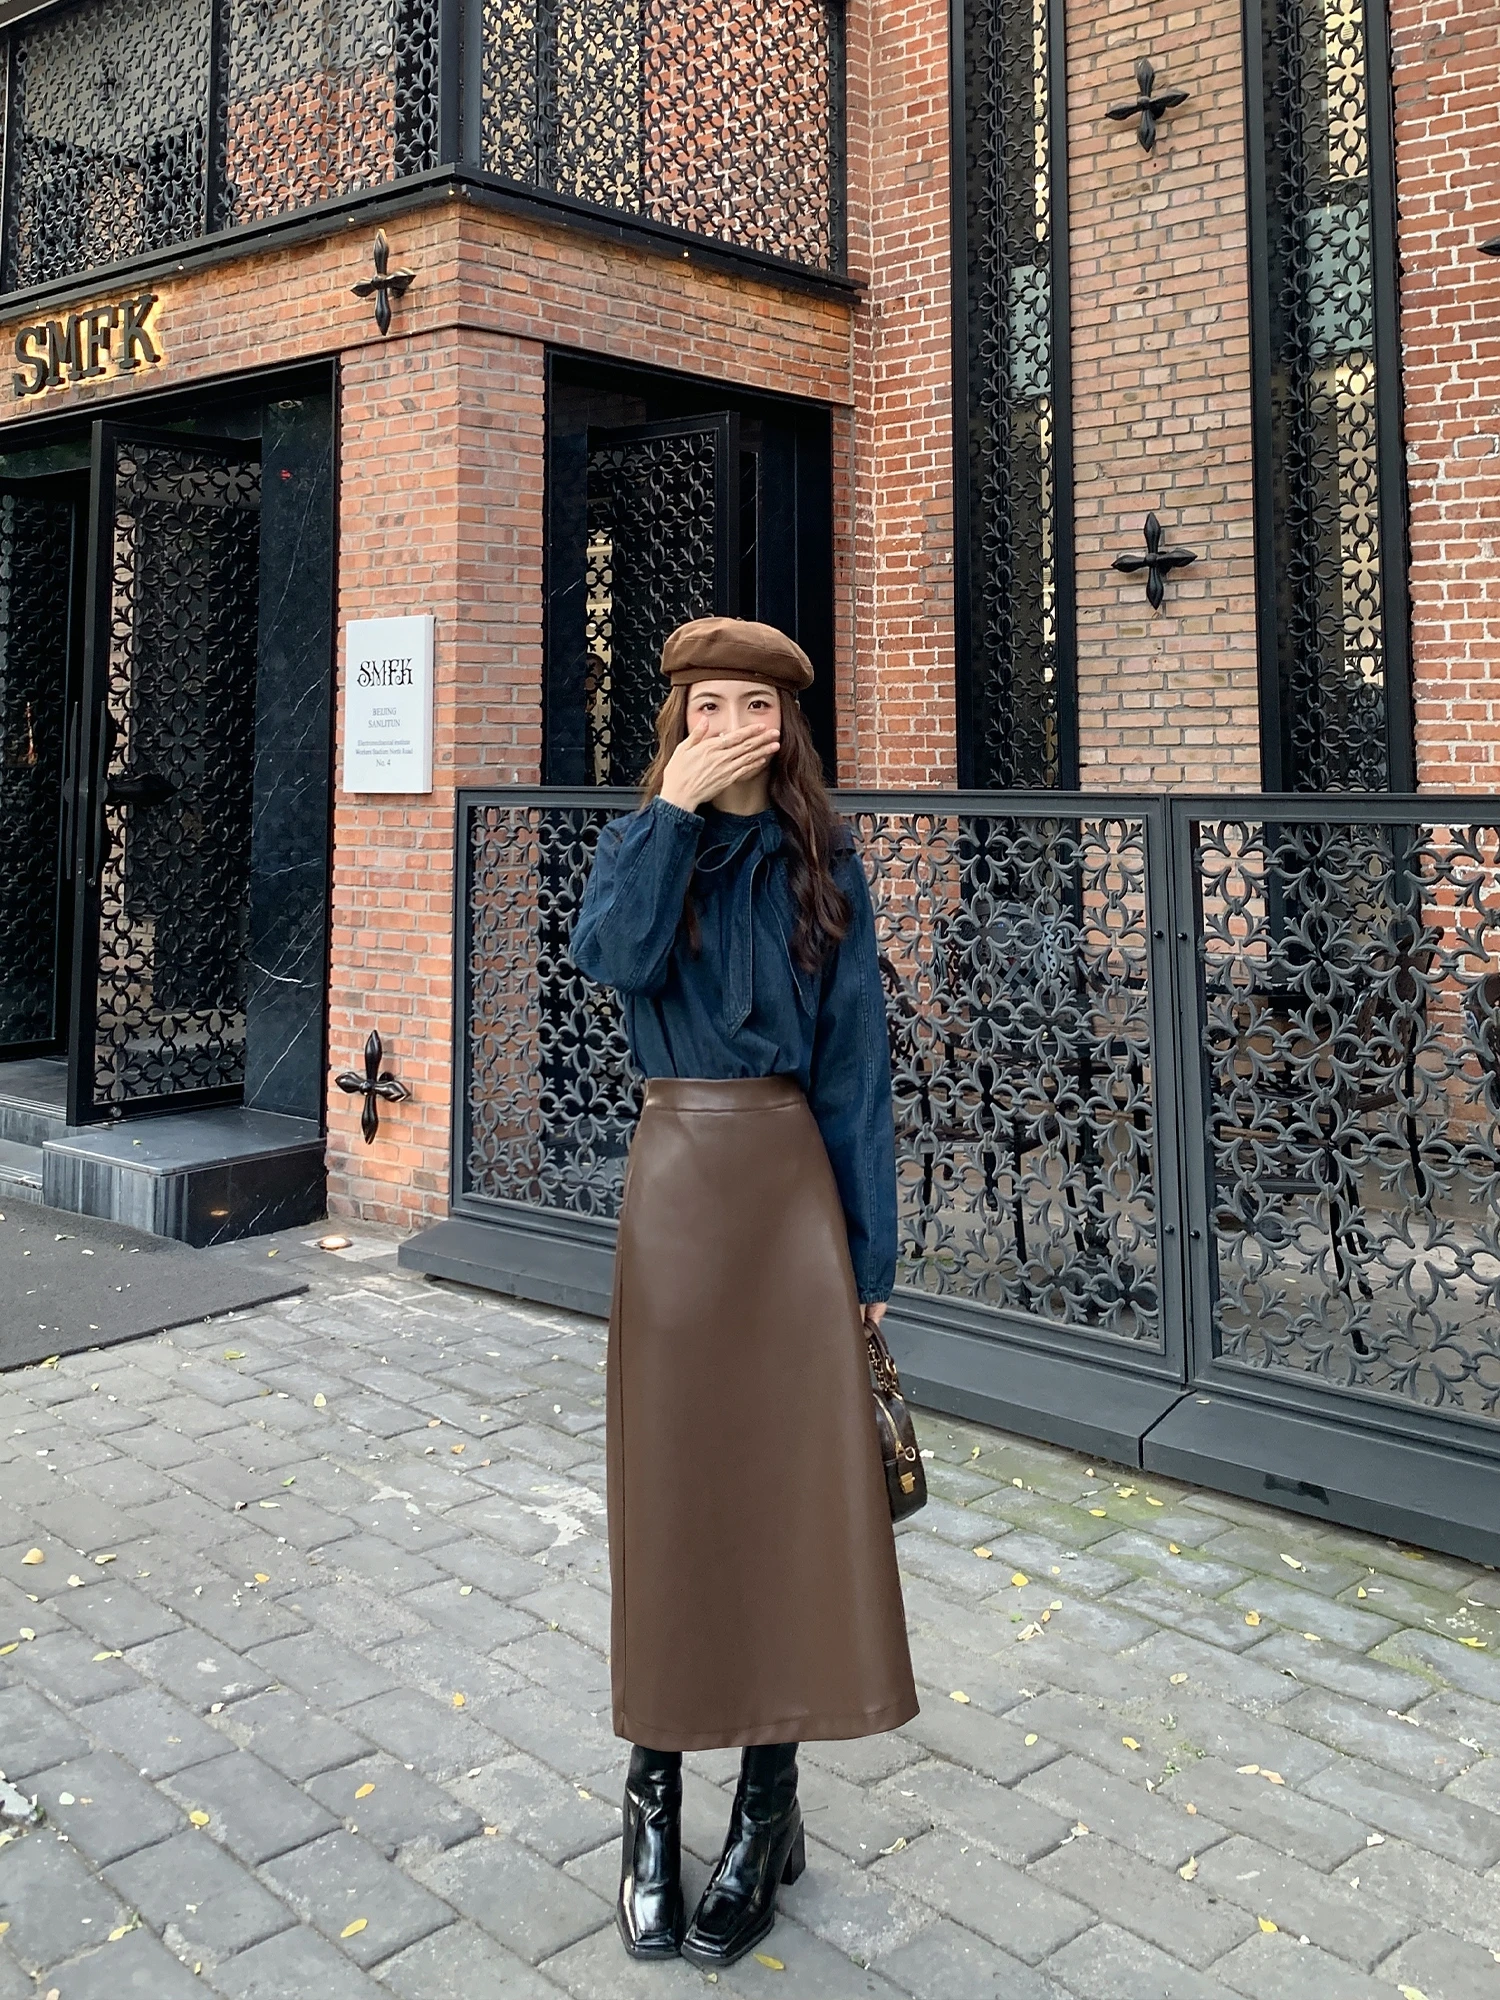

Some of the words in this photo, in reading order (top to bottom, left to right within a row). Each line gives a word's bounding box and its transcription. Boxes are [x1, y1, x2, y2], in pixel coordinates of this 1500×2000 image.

[13, 293, 161, 396] SMFK
[357, 657, 413, 687] SMFK
[372, 707, 397, 716] BEIJING
[368, 719, 401, 728] SANLITUN
